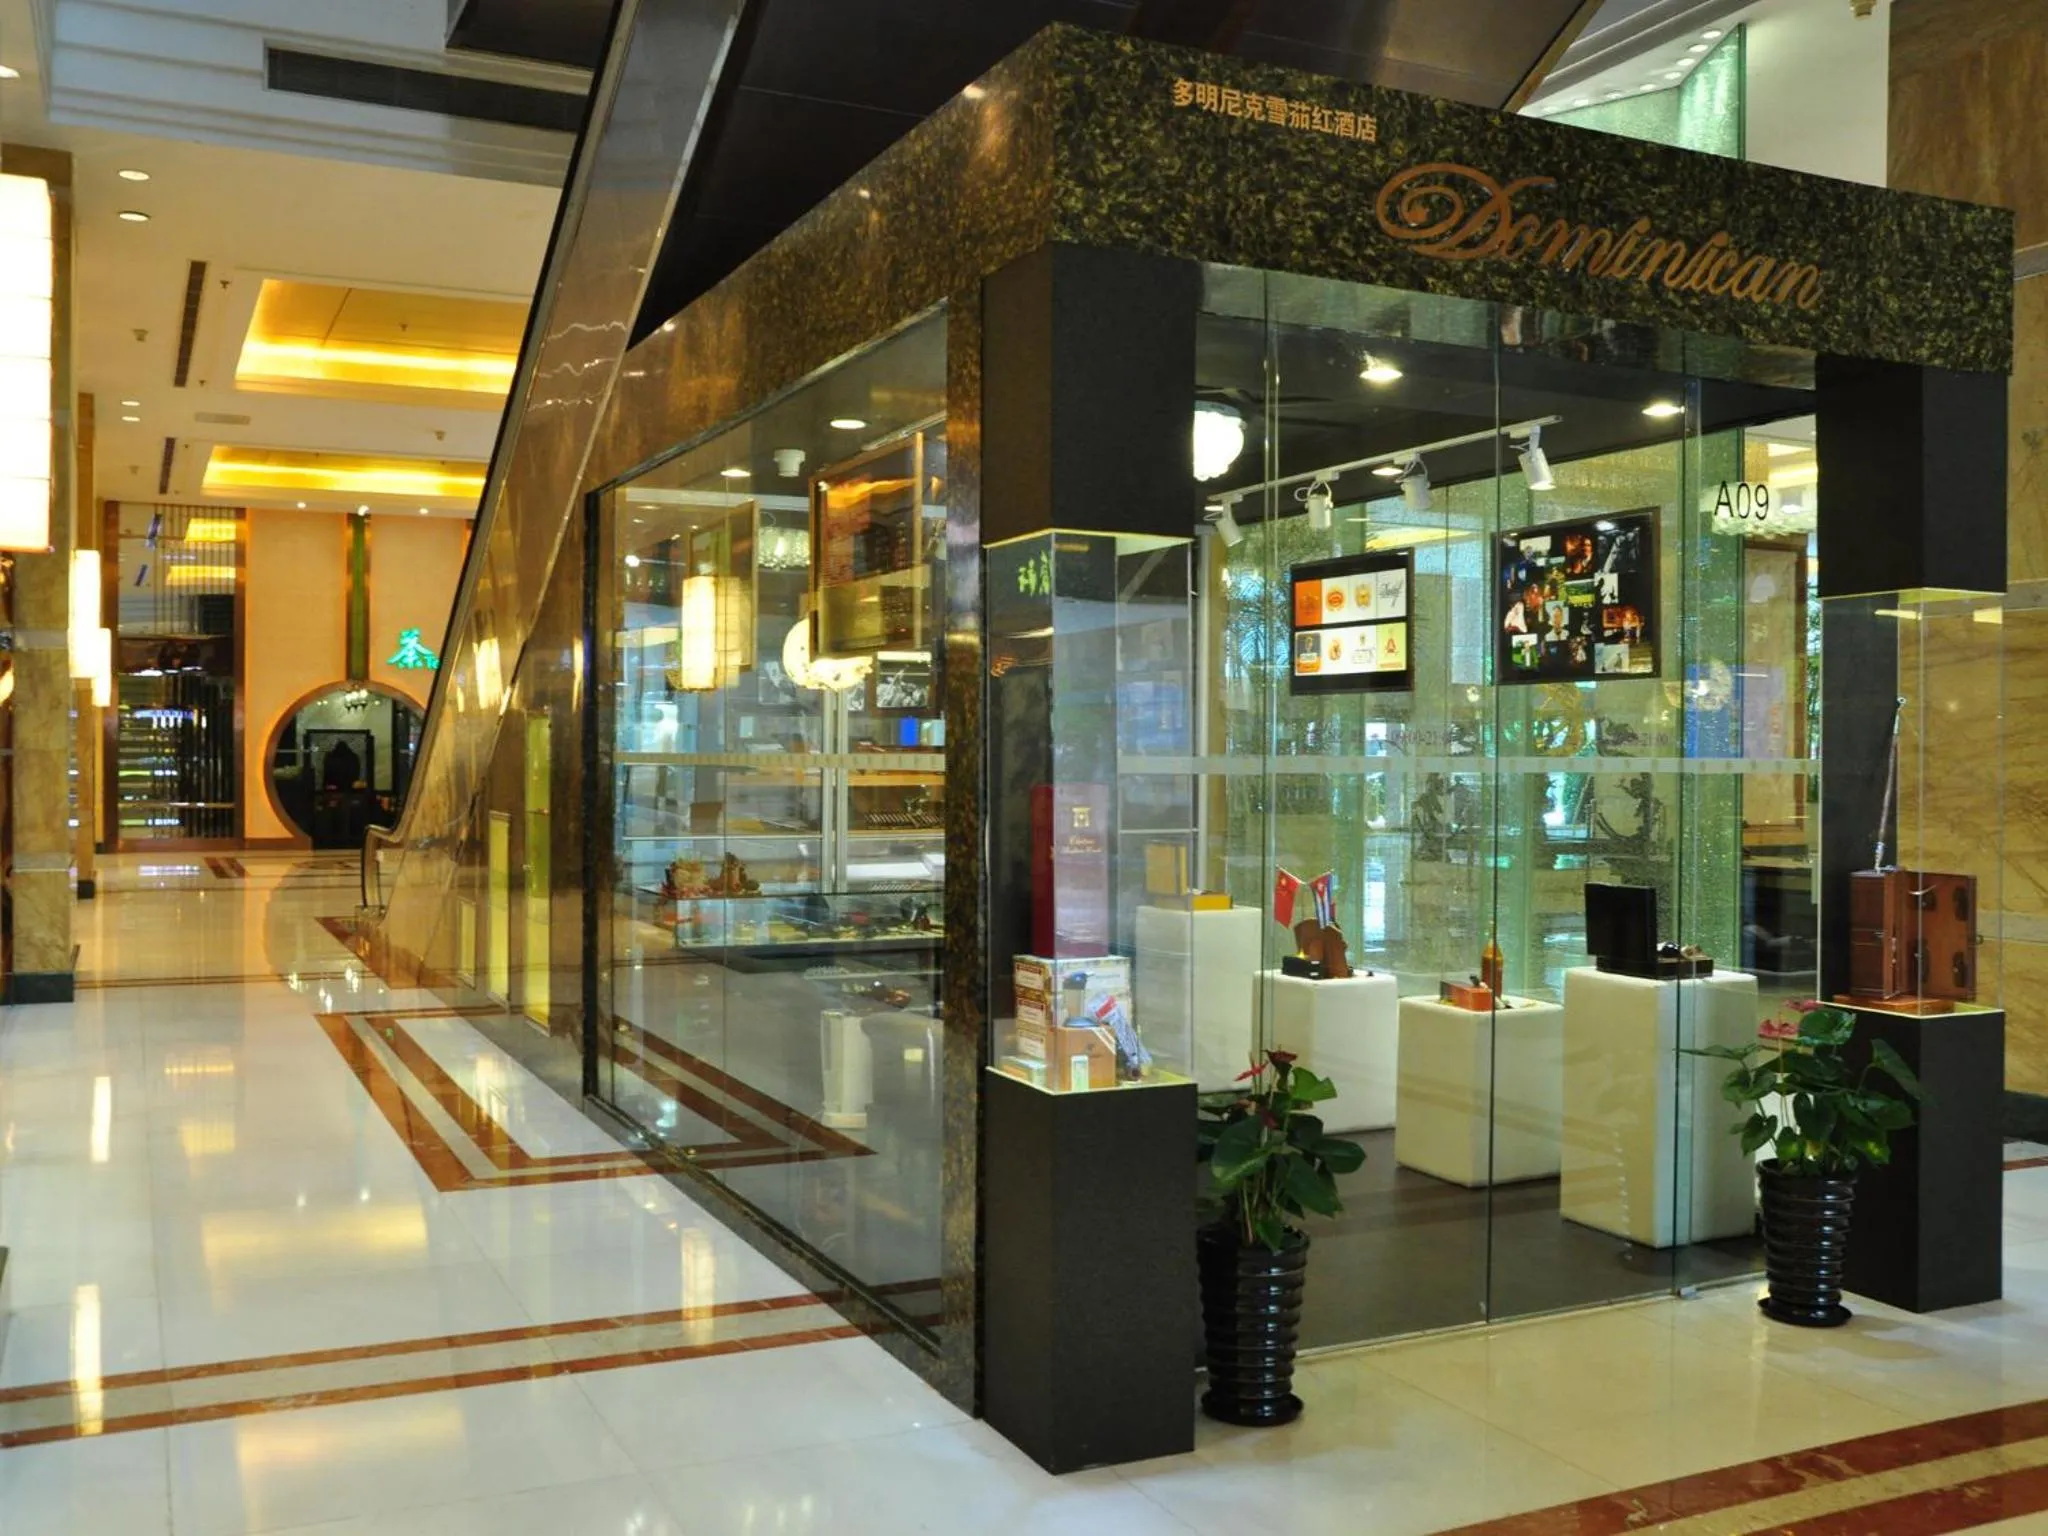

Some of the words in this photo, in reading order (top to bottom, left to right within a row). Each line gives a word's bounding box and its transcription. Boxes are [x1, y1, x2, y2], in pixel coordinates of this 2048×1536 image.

[1172, 78, 1378, 143] 多明尼克雪茄红酒店
[1375, 162, 1824, 309] Dominican
[1713, 480, 1770, 521] A09
